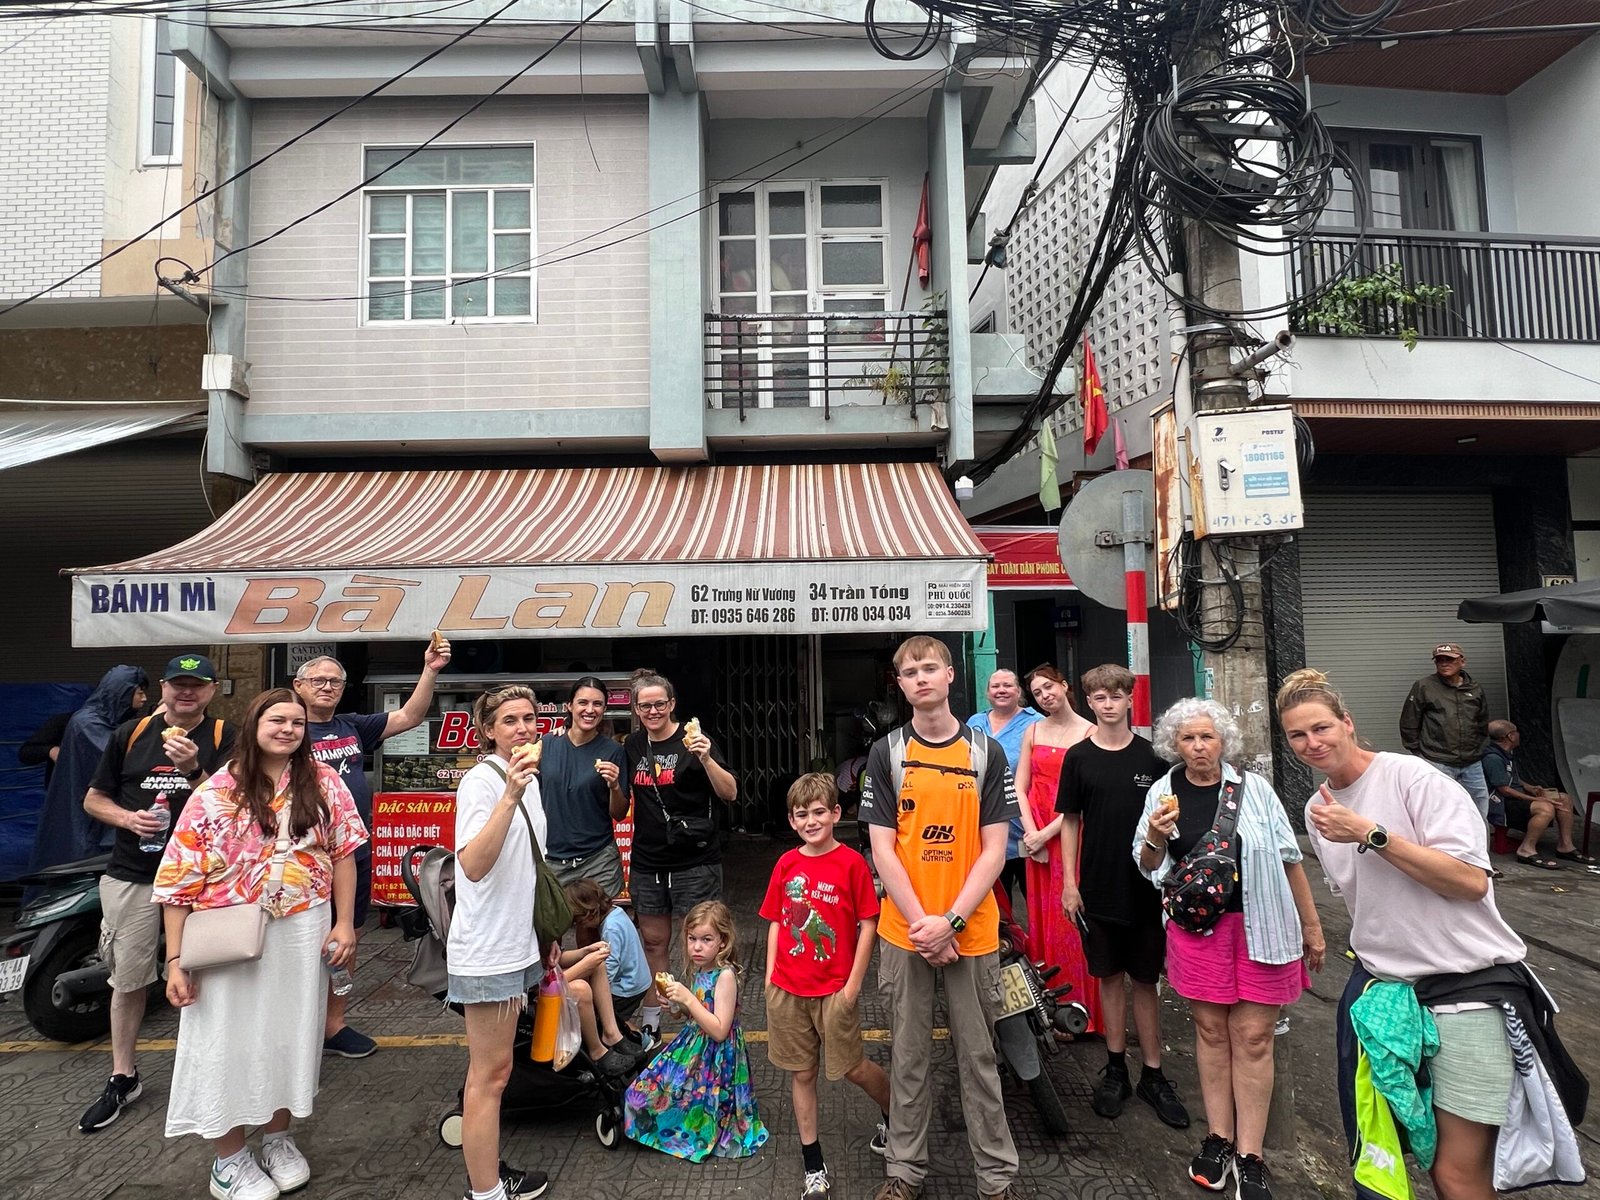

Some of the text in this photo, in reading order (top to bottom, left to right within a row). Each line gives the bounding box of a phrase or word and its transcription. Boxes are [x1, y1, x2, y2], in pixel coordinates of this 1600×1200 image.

[1244, 452, 1285, 462] 18001166
[1001, 560, 1019, 574] TOÀN
[91, 577, 216, 613] BÁNH MÌ
[691, 584, 708, 602] 62
[712, 588, 742, 602] Trưng
[762, 587, 795, 602] Vương
[809, 583, 827, 600] 34
[928, 588, 971, 600] PHÚ QUỐC
[224, 574, 676, 635] Bà Lan
[691, 607, 796, 624] ĐT: 0935 646 286
[811, 605, 911, 622] ĐT: 0778 034 034
[437, 770, 449, 778] 62
[140, 782, 175, 790] GRAND
[378, 800, 405, 816] ĐẶC
[406, 800, 432, 813] SẢN
[376, 823, 392, 838] CHẢ
[406, 824, 422, 841] ĐẶC
[423, 824, 440, 841] BIỆT
[922, 825, 953, 840] ON
[376, 842, 392, 857] CHẢ
[375, 861, 392, 877] CHẢ
